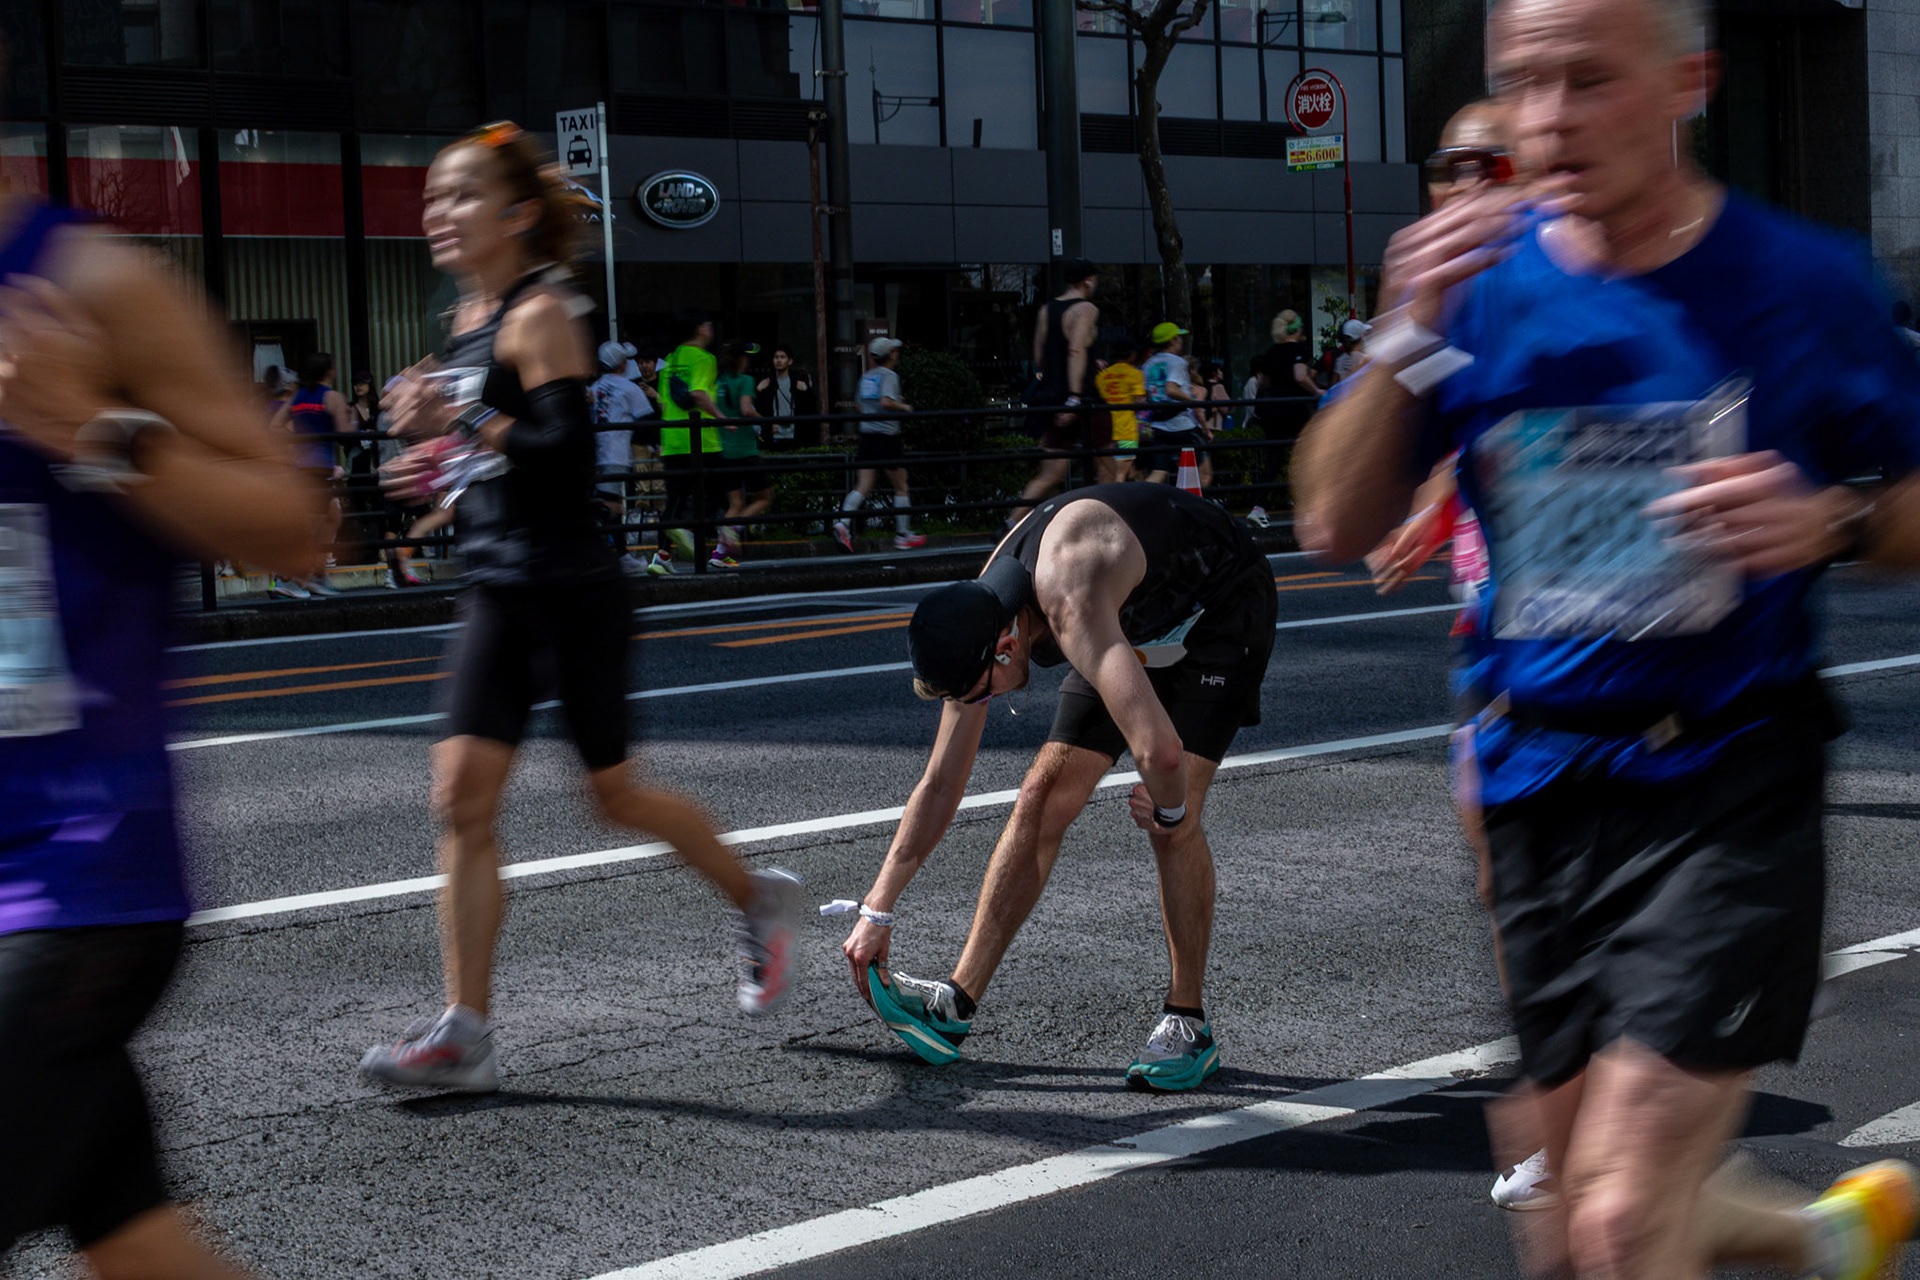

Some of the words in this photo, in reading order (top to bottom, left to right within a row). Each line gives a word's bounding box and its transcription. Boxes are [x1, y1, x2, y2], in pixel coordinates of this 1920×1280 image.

[1298, 92, 1332, 114] 消火栓
[560, 114, 594, 133] TAXI
[659, 183, 695, 198] LAND
[661, 199, 706, 214] ROVER
